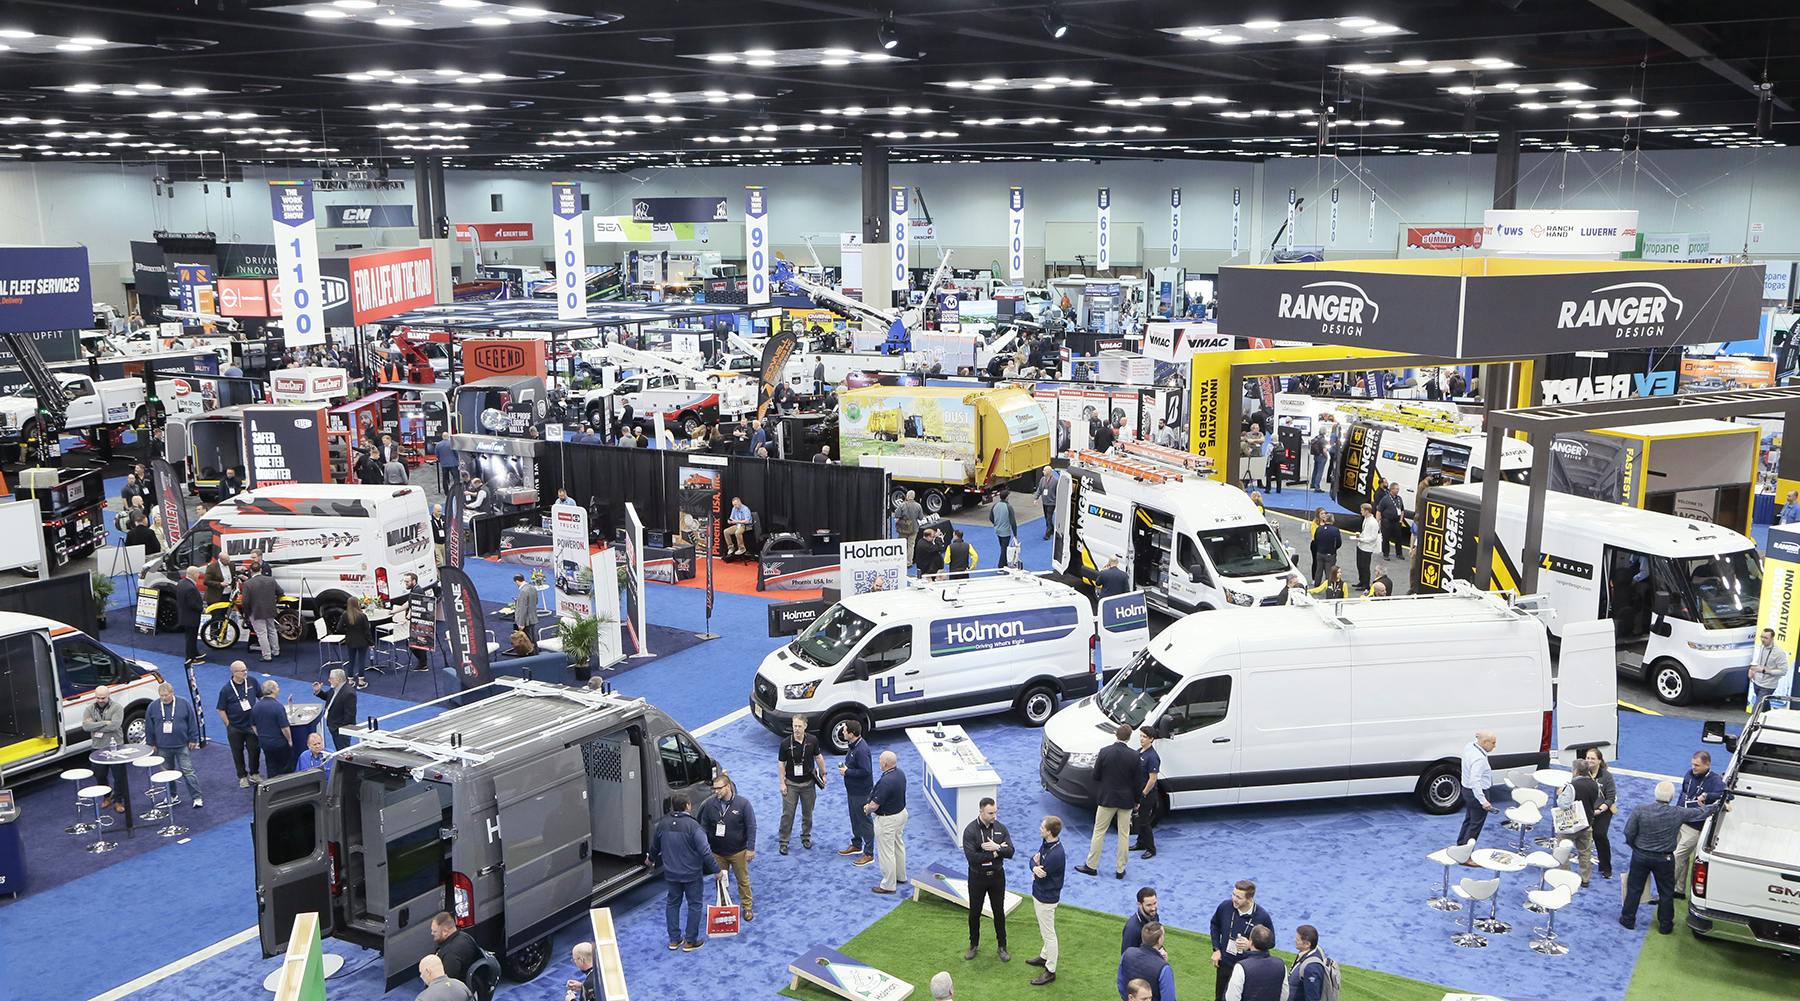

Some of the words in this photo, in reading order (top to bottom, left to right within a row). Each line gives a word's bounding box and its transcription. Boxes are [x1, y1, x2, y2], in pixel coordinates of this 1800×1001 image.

[280, 196, 304, 204] WORK
[285, 188, 298, 196] THE
[281, 204, 304, 212] TRUCK
[283, 212, 304, 220] SHOW
[342, 208, 372, 220] CM
[1504, 227, 1524, 236] UWS
[1580, 227, 1617, 237] LUVERNE
[895, 222, 905, 282] 800
[1013, 218, 1021, 271] 700
[751, 227, 764, 294] 900
[564, 229, 578, 310] 1000
[10, 279, 37, 296] FLEET
[37, 276, 80, 295] SERVICES
[289, 237, 312, 335] 1100
[353, 268, 372, 313] FOR
[379, 265, 393, 307] LIFE
[391, 263, 404, 303] ON
[401, 260, 416, 300] THE
[414, 258, 433, 297] ROAD
[1278, 292, 1365, 324] RANGER
[1557, 296, 1668, 329] RANGER
[33, 330, 64, 341] UPFIT
[1322, 323, 1363, 337] DESIGN
[1616, 326, 1665, 338] DESIGN
[1149, 335, 1171, 348] VMAC
[1187, 337, 1230, 349] VMAC
[478, 348, 520, 369] LEGEND
[188, 399, 201, 408] Shop
[1199, 379, 1209, 438] TAILORED
[1208, 378, 1218, 447] INNOVATIVE
[251, 419, 257, 431] A
[252, 432, 276, 443] SAFER
[253, 444, 282, 456] COOLER
[254, 456, 285, 468] QUIETER
[1357, 428, 1377, 496] RANGER
[1622, 448, 1634, 500] FASTEST
[1077, 475, 1094, 551] RANGER
[1089, 505, 1100, 514] EV
[168, 498, 181, 548] VALLEY
[559, 522, 580, 530] TRUCKS
[386, 523, 422, 547] VALLEY
[712, 517, 721, 555] Phoenix
[226, 536, 276, 556] VALLEY
[290, 533, 360, 548] MOTORSPORTS
[844, 543, 904, 559] Holman
[1441, 506, 1461, 593] RANGER
[1556, 560, 1590, 575] READY
[339, 573, 366, 582] VALLEY
[792, 578, 812, 586] Phoenix
[450, 582, 465, 613] ONE
[1777, 569, 1795, 642] INNOVATIVE
[782, 609, 816, 621] Holman
[456, 615, 472, 664] FLEET
[947, 619, 1024, 645] Holman
[975, 642, 994, 650] Driving
[993, 640, 1011, 649] What's
[1011, 638, 1025, 647] Right
